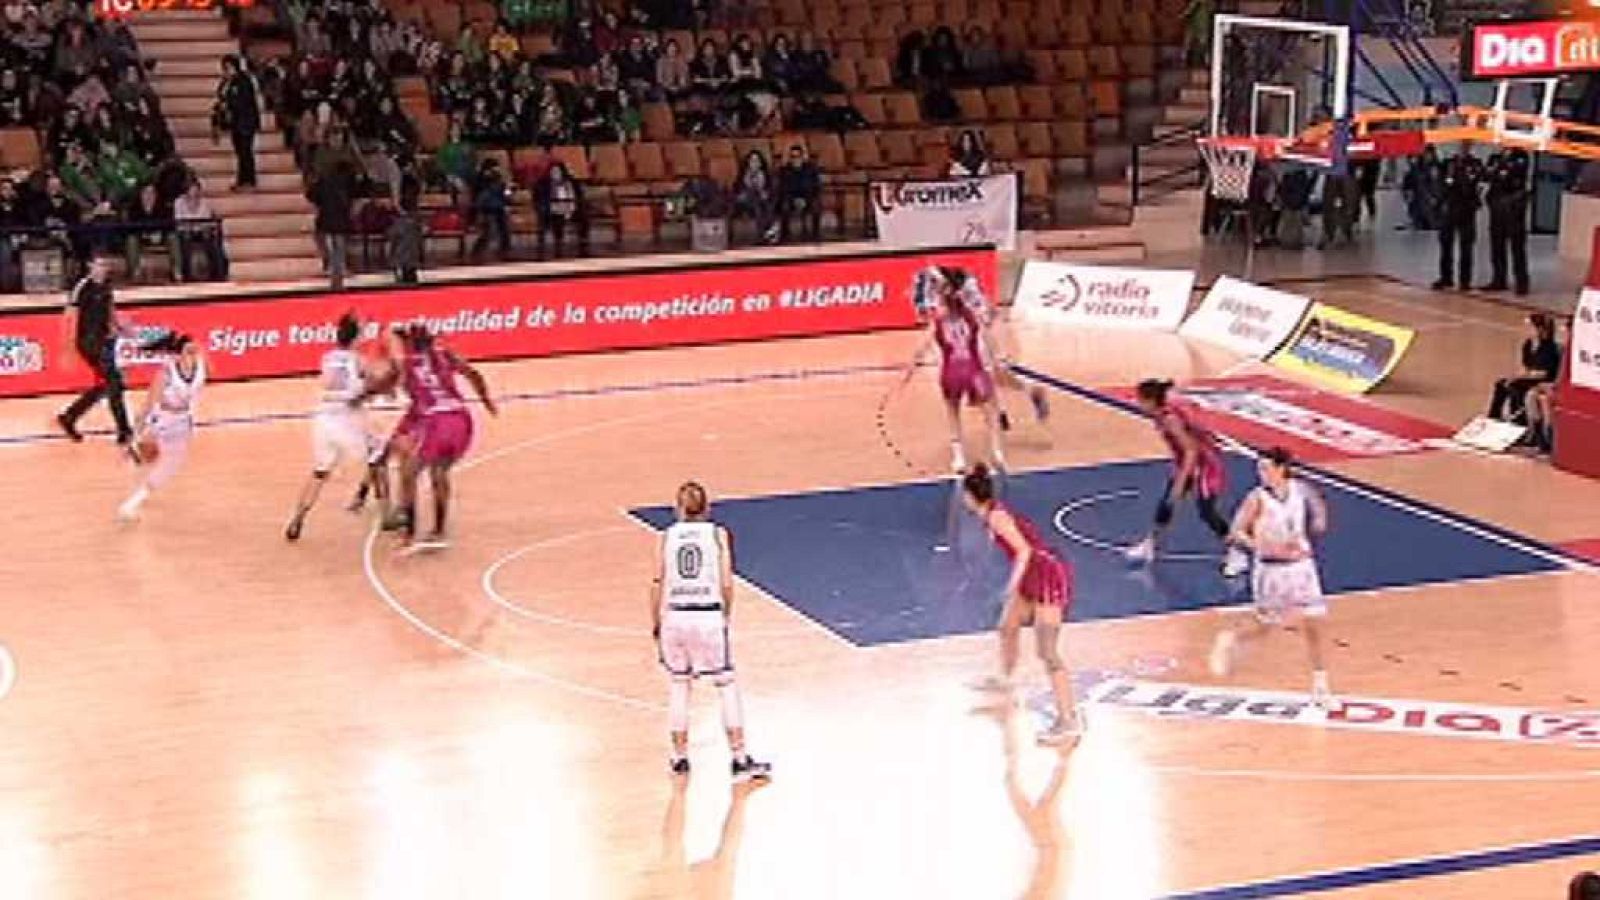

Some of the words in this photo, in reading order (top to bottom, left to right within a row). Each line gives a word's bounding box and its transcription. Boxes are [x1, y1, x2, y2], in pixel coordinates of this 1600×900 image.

[1087, 278, 1151, 299] radio
[208, 325, 280, 355] Sigue
[288, 322, 339, 344] tod
[390, 306, 520, 336] ualidad
[526, 304, 556, 328] de
[563, 301, 587, 324] la
[593, 291, 736, 325] competición
[742, 293, 771, 312] en
[677, 542, 702, 580] 0
